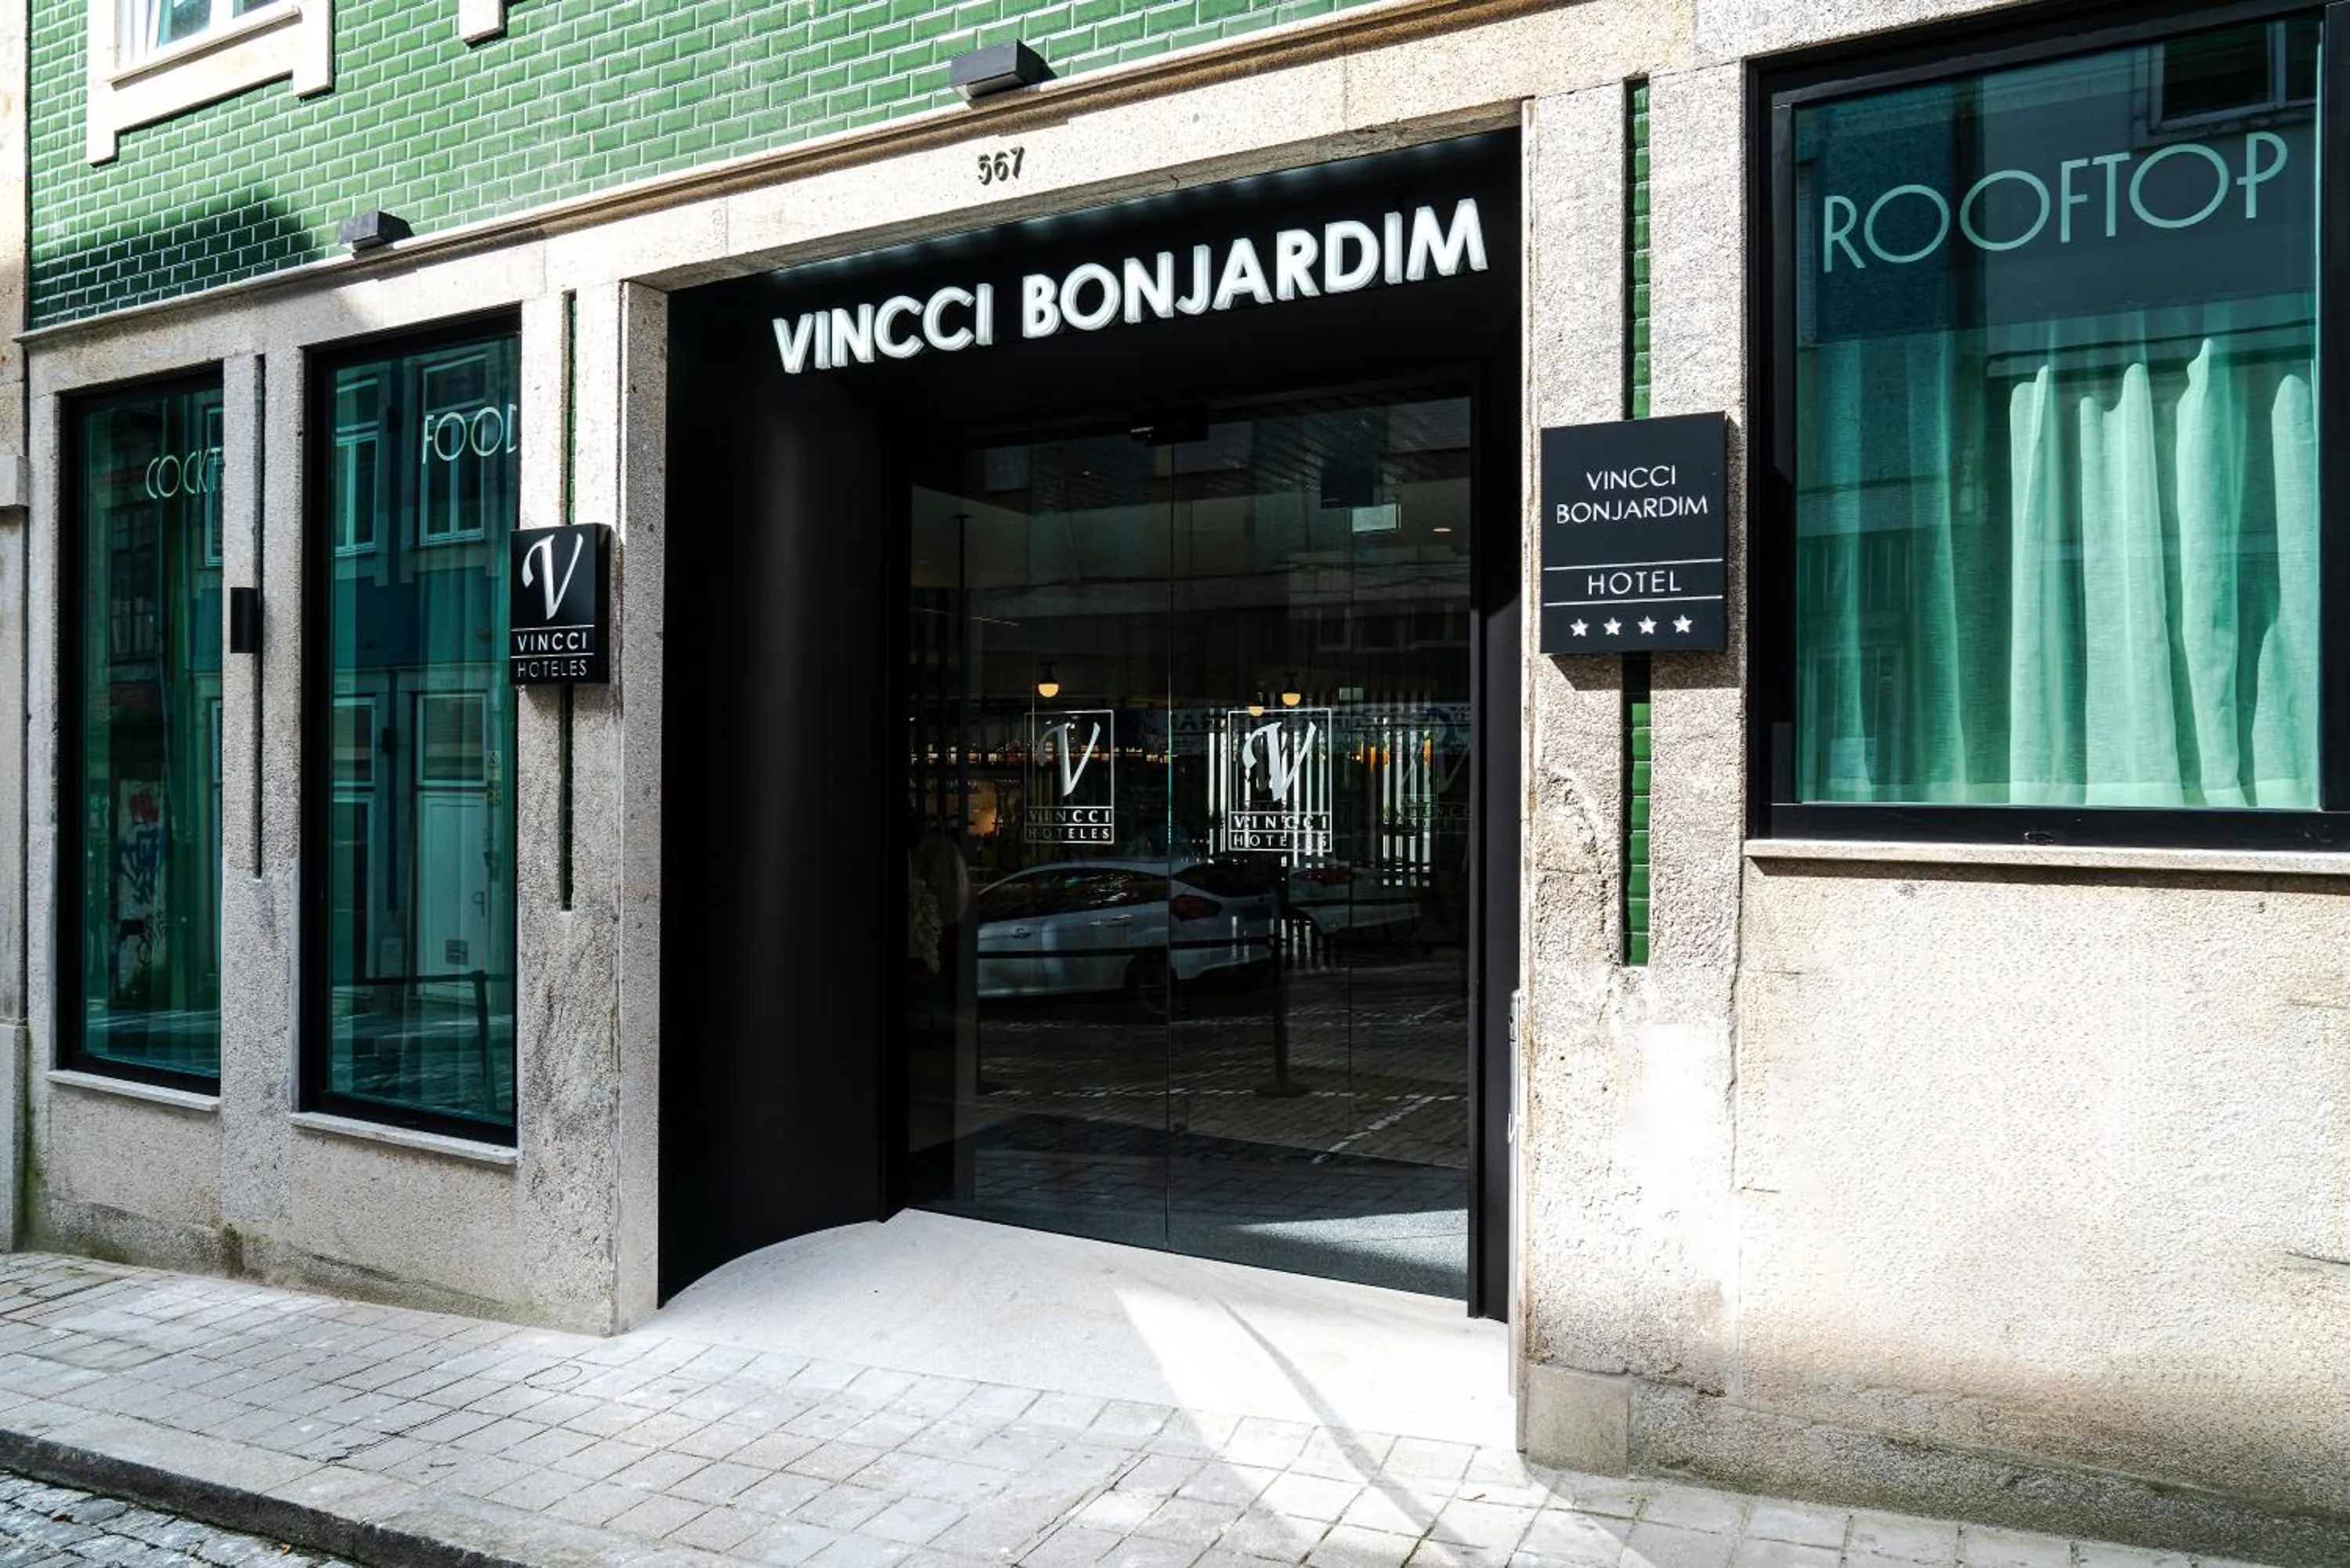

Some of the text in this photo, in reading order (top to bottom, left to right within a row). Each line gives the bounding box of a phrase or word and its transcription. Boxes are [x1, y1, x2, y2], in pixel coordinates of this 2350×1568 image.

[978, 146, 1025, 186] 567
[1821, 130, 2289, 274] ROOFTOP
[772, 197, 1491, 374] VINCCI BONJARDIM
[1586, 464, 1676, 491] VINCCI
[1556, 495, 1708, 525] BONJARDIM
[521, 533, 584, 621] V
[1588, 570, 1682, 595] HOTEL
[517, 631, 588, 652] VINCCI
[518, 659, 588, 678] HOTELES
[1029, 809, 1110, 823] VINCCI
[1234, 815, 1327, 830] VINCCI
[1029, 828, 1110, 840] HOTELES
